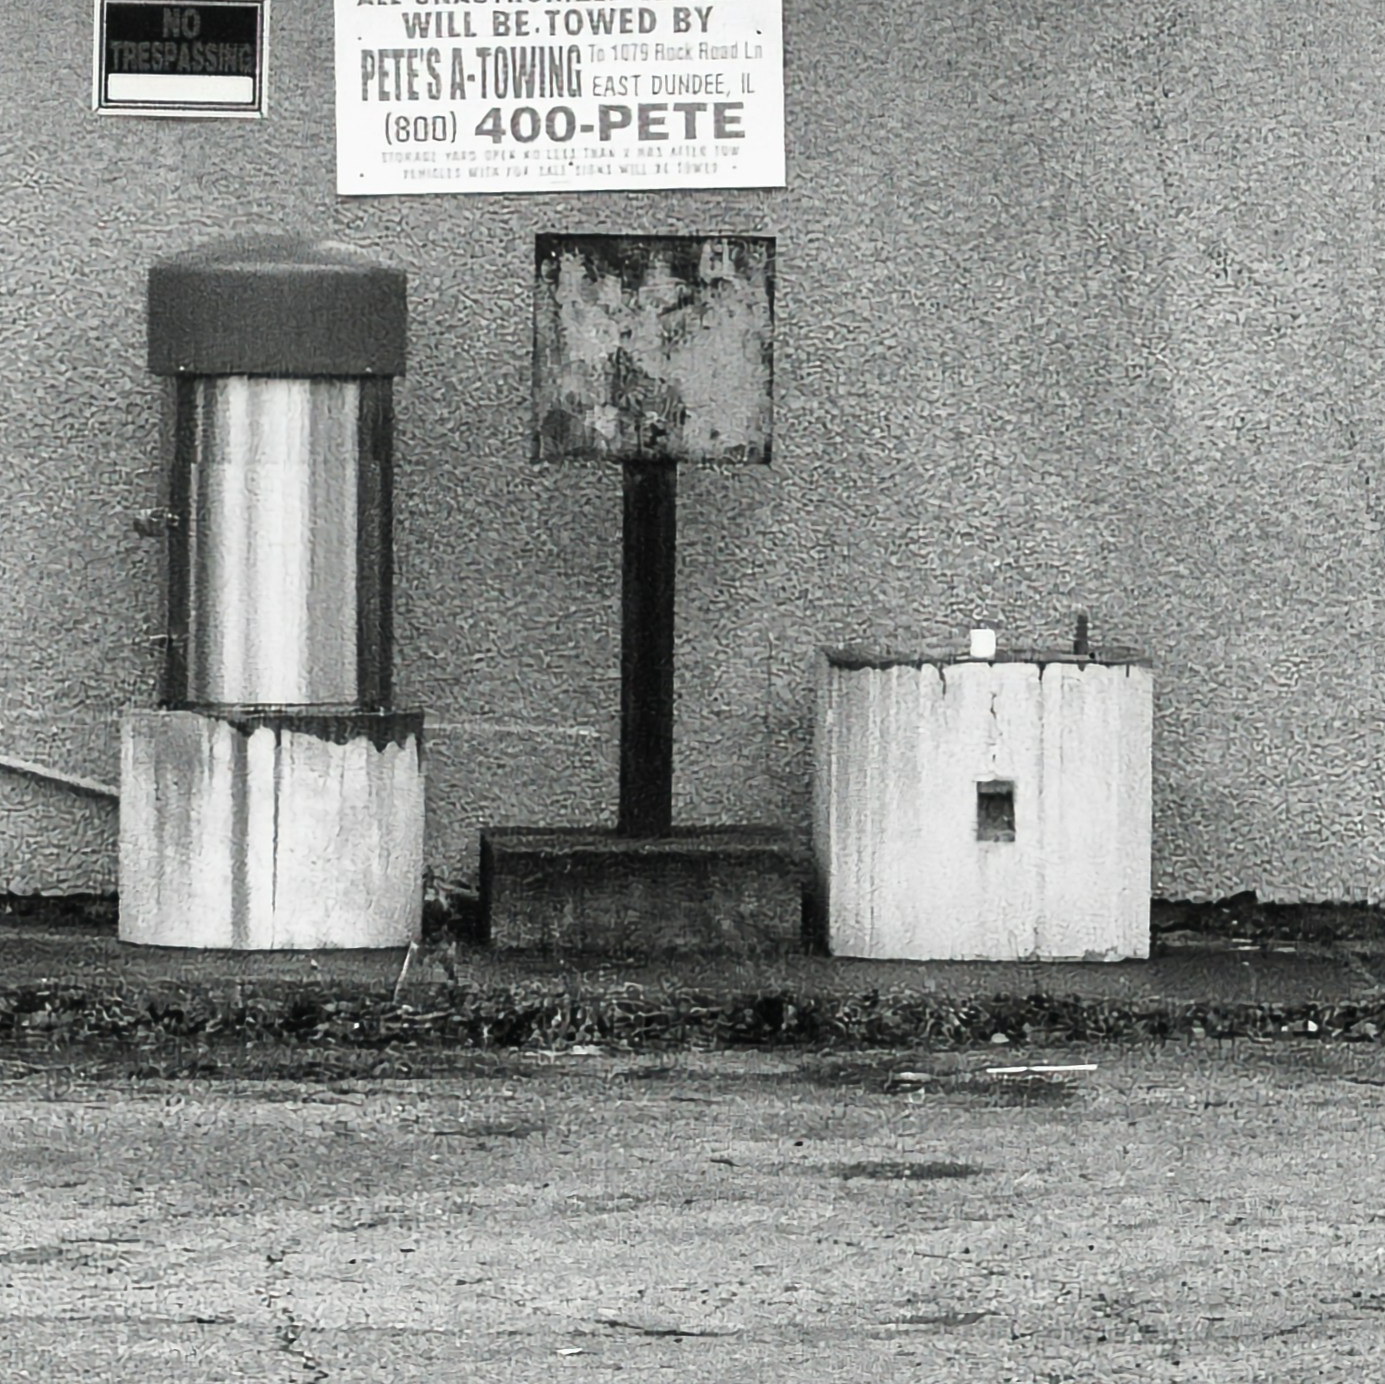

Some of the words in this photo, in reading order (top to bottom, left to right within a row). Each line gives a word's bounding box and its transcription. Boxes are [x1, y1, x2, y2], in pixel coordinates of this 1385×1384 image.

[162, 7, 201, 38] NO
[402, 10, 477, 39] WILL
[492, 9, 530, 37] BE
[544, 7, 658, 36] TOWED
[673, 5, 714, 34] BY
[111, 40, 254, 74] TRESPASSING
[588, 44, 605, 63] To
[611, 43, 649, 62] 1079
[655, 42, 693, 61] Rock
[699, 41, 738, 60] Road
[745, 41, 763, 59] Ln
[361, 46, 442, 102] PETE'S
[450, 44, 582, 101] A-TOWING
[593, 74, 642, 97] EAST
[652, 73, 731, 97] DUNDEE,
[741, 72, 756, 94] IL
[385, 110, 458, 146] (800)
[474, 102, 746, 144] 400-PETE
